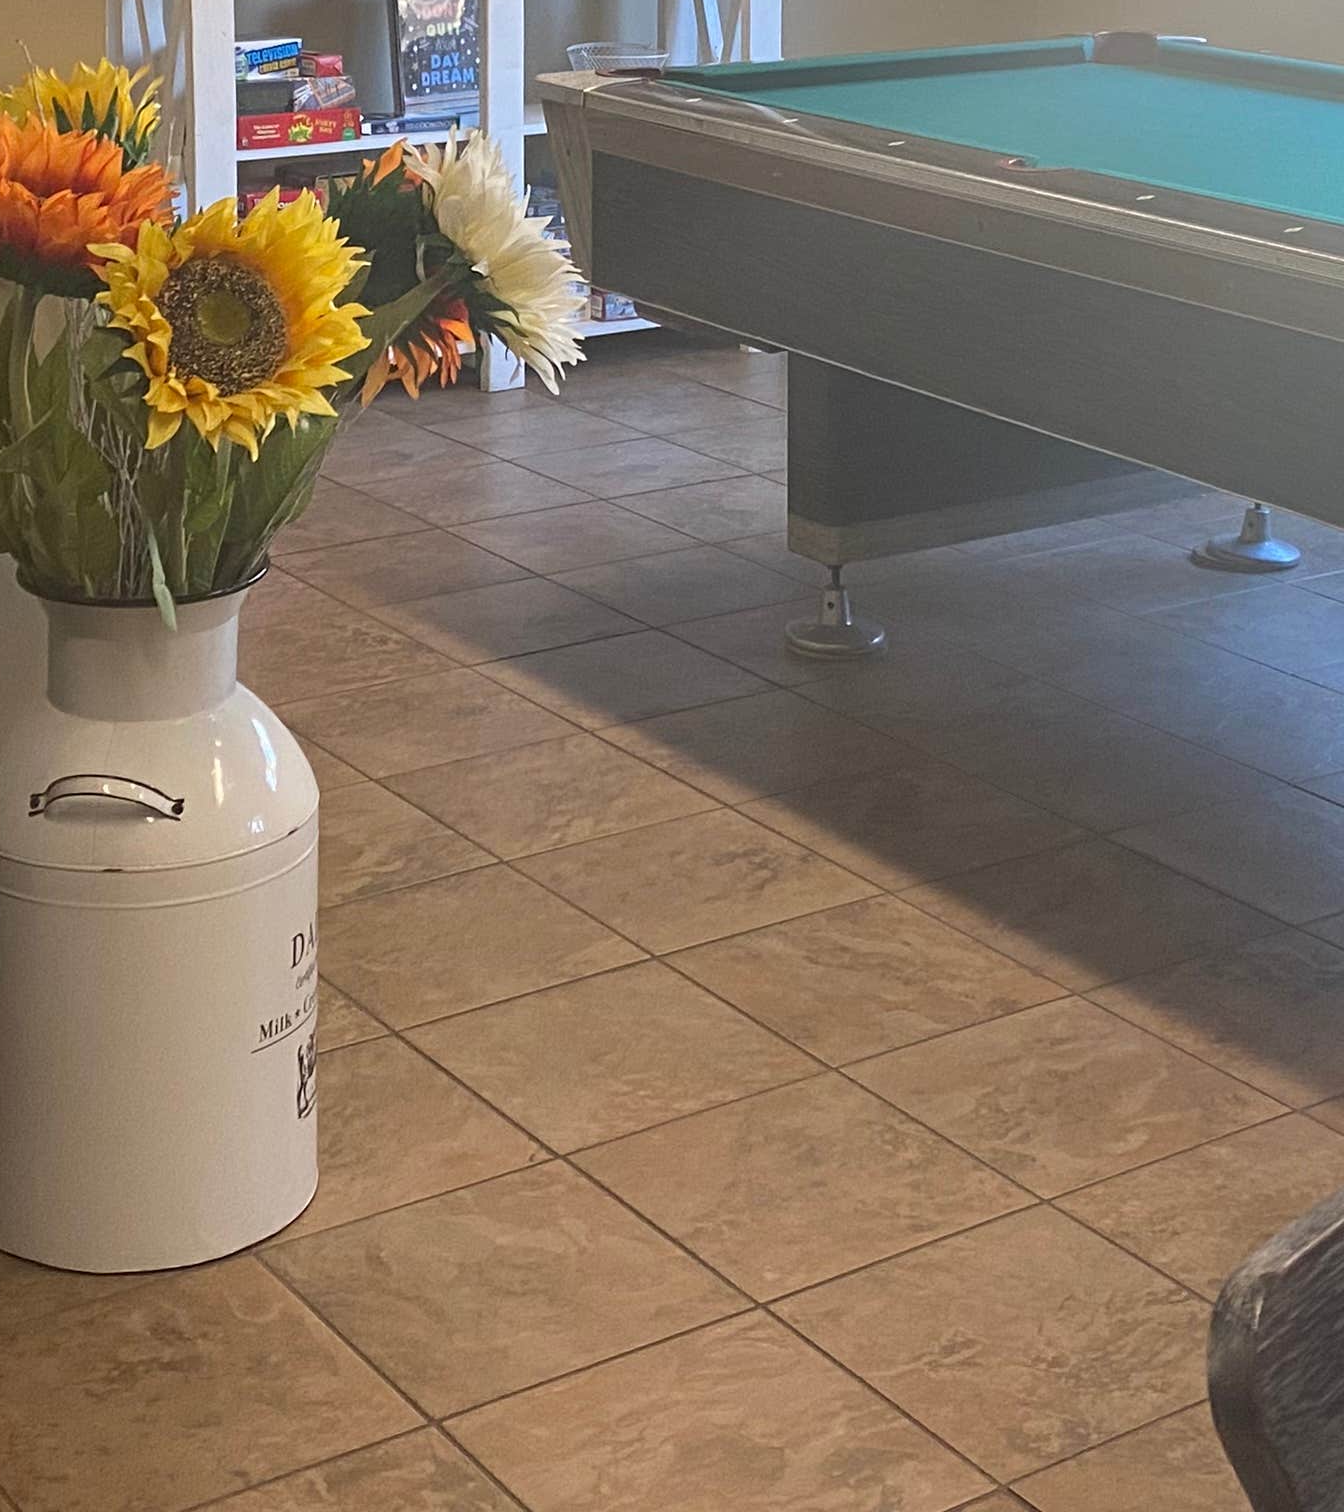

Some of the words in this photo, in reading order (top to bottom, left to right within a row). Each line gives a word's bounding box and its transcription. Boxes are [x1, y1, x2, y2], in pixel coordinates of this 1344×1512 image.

[426, 22, 461, 37] QUIT
[430, 52, 460, 70] DAY
[420, 67, 475, 86] DREAM
[258, 1013, 293, 1043] Milk
